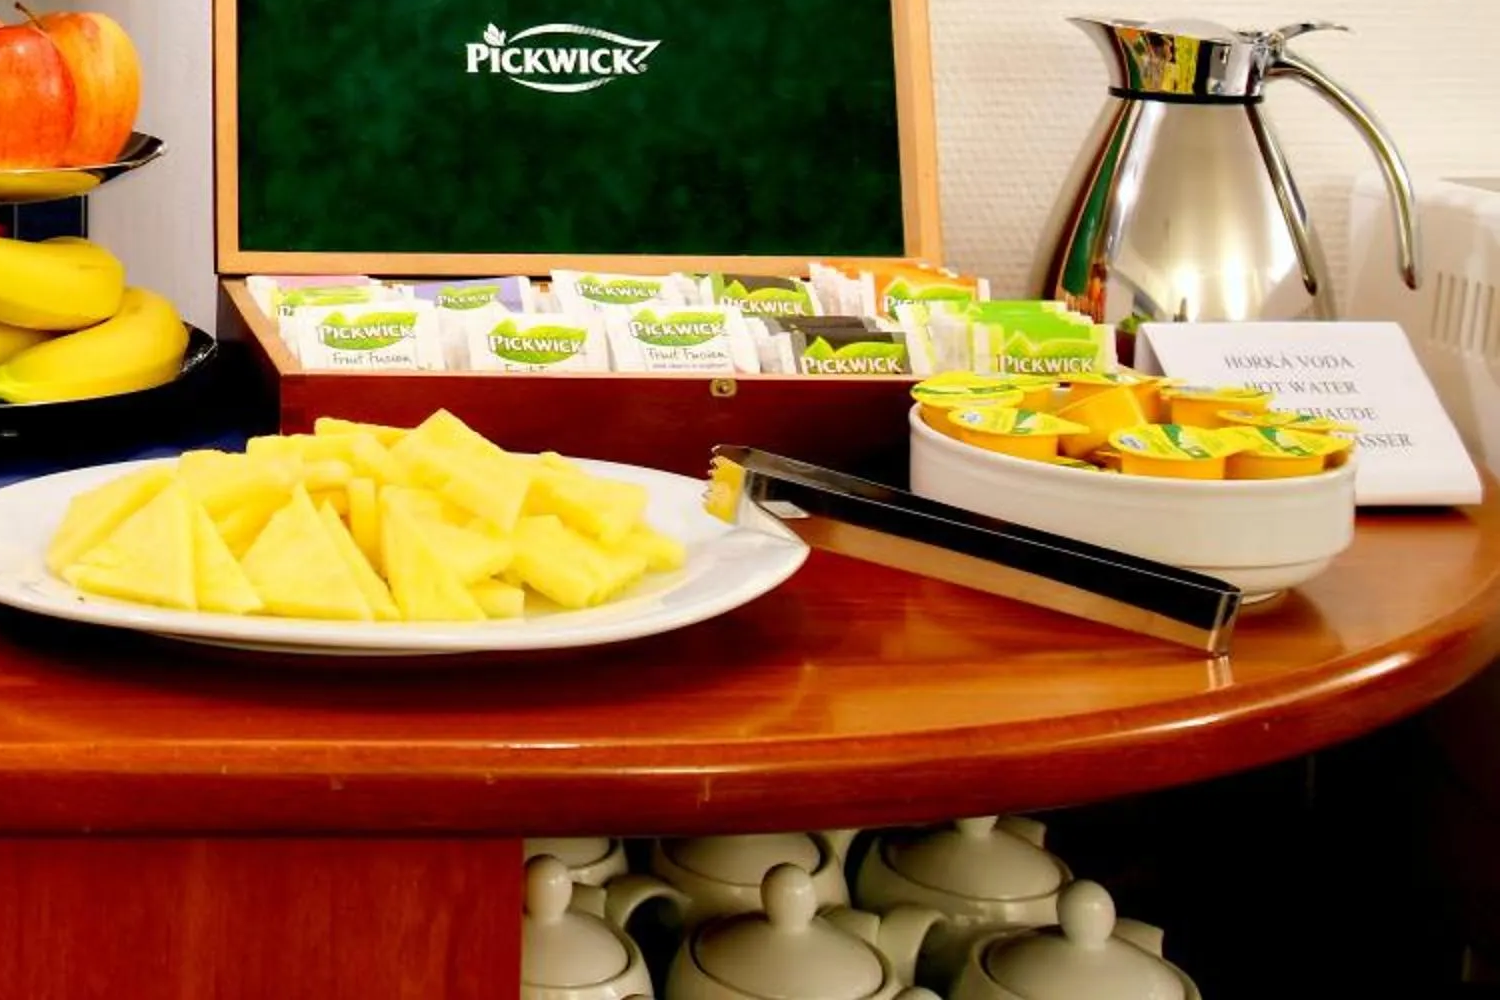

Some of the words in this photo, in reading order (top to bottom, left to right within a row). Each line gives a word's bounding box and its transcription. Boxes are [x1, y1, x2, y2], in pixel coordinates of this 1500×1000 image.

[465, 42, 639, 75] PICKWICK
[577, 282, 658, 298] PICKWICK
[318, 324, 414, 340] PICKWICK
[630, 321, 723, 337] PICKWICK
[489, 334, 581, 353] PICKWICK
[801, 357, 903, 374] PICKWICK
[999, 354, 1094, 373] PICKWICK
[1296, 355, 1355, 369] VODA
[1287, 381, 1359, 394] WATER
